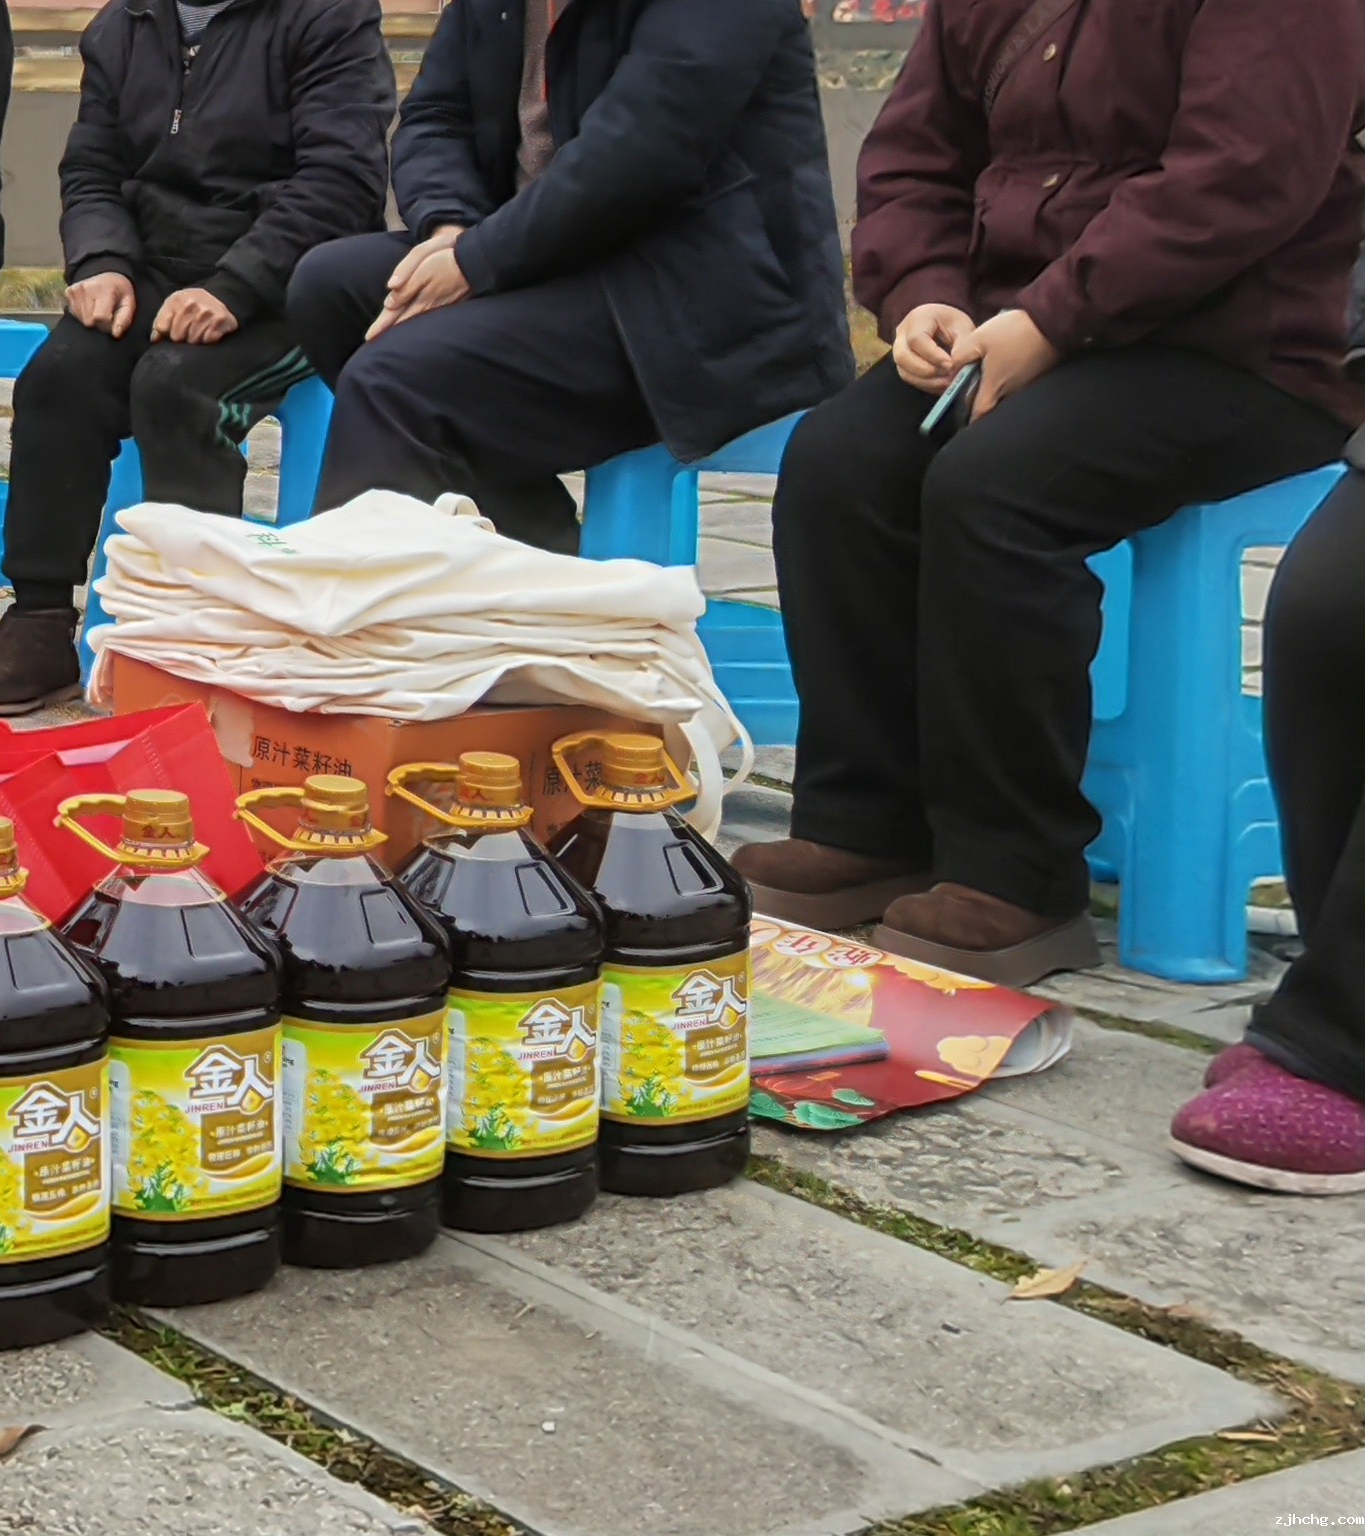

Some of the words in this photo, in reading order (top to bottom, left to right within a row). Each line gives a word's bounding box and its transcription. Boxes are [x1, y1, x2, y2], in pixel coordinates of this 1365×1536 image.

[252, 736, 352, 777] 原汁菜籽油
[672, 974, 747, 1022] 金人
[519, 1003, 597, 1056] 金人
[671, 1019, 709, 1031] JINREN
[360, 1034, 442, 1086] 金人
[518, 1049, 557, 1061] JINREN
[184, 1051, 274, 1107] 金人
[358, 1081, 397, 1093] JINREN
[9, 1087, 100, 1145] 金人
[184, 1101, 225, 1114] JINREN
[8, 1140, 50, 1153] JINREN
